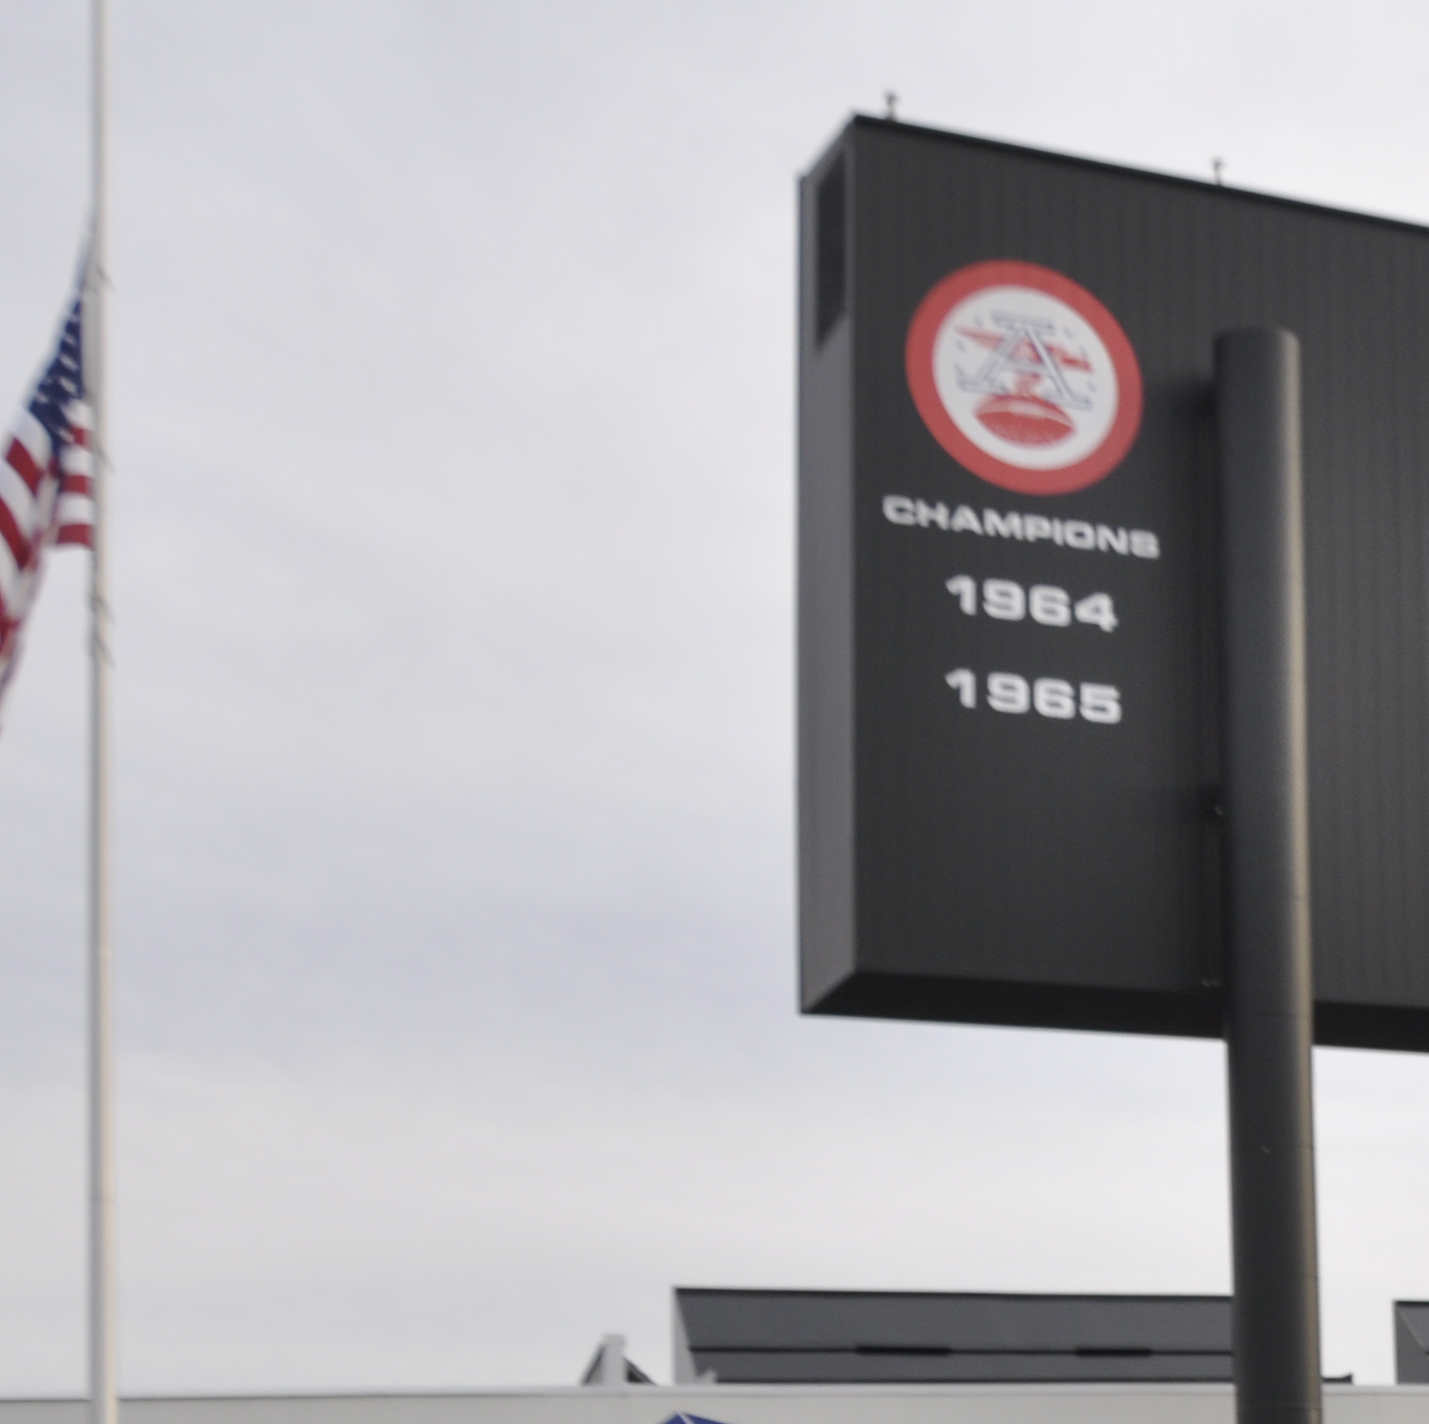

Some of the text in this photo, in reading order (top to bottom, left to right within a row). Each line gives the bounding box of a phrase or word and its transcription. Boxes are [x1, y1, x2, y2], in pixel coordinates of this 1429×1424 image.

[882, 495, 1160, 560] CHAMPIONS
[945, 575, 1118, 633] 1964
[945, 668, 1122, 724] 1965
